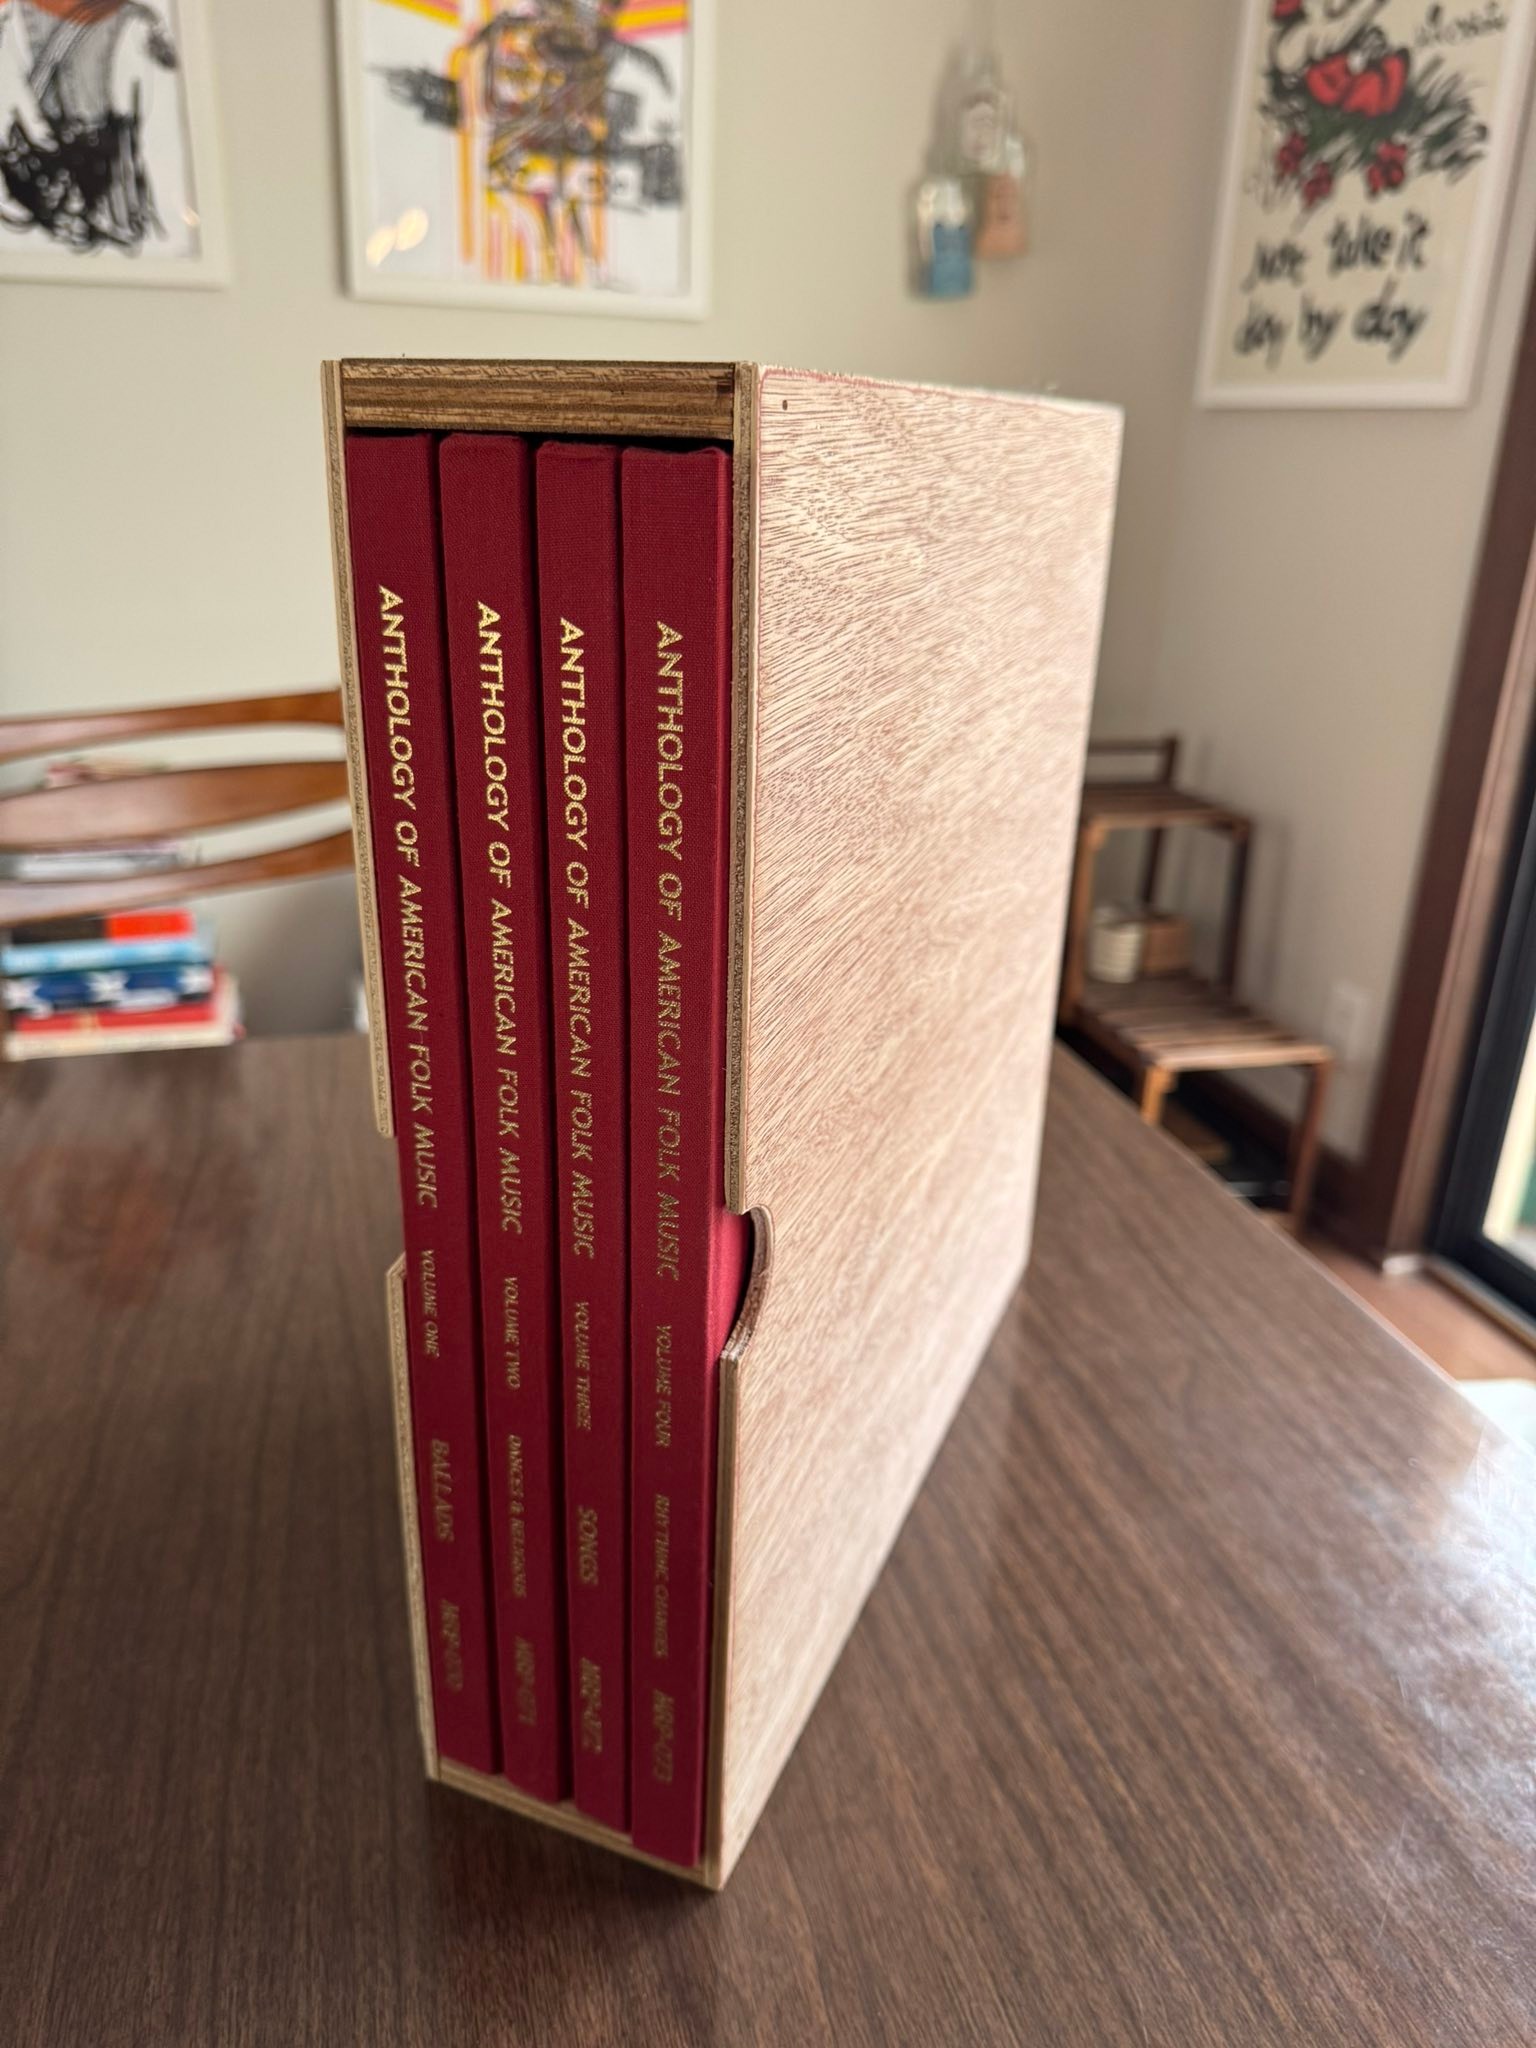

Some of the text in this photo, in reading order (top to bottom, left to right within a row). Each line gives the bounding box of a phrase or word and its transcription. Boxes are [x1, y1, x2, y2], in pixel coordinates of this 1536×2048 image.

[1298, 293, 1344, 363] by
[1353, 277, 1429, 364] day
[379, 584, 416, 811] ANTHOLOGY
[477, 600, 510, 831] ANTHOLOGY
[559, 617, 588, 850] ANTHOLOGY
[657, 620, 684, 860] ANTHOLOGY
[395, 821, 420, 867] OF
[488, 841, 512, 888] OF
[566, 861, 590, 909] OF
[658, 872, 683, 921] OF
[398, 874, 429, 1032] AMERICAN
[491, 898, 517, 1056] AMERICAN
[567, 917, 591, 1078] AMERICAN
[657, 930, 682, 1095] AMERICAN
[409, 1043, 433, 1115] FOLK
[497, 1067, 520, 1139] FOLK
[570, 1089, 593, 1162] FOLK
[657, 1107, 681, 1182] FOLK
[414, 1122, 437, 1209] MUSIC
[499, 1147, 522, 1235] MUSIC
[572, 1170, 595, 1260] MUSIC
[657, 1191, 680, 1281] MUSIC
[421, 1249, 438, 1317] VOLUME
[504, 1276, 520, 1347] VOLUME
[424, 1321, 440, 1358] ONE
[505, 1351, 521, 1391] TWO
[575, 1301, 591, 1371] VOLUME
[656, 1325, 672, 1395] VOLUME
[576, 1375, 592, 1431] THREE
[655, 1400, 672, 1448] FOUR
[431, 1438, 454, 1542] BALLADS
[508, 1434, 525, 1499] DANCES
[510, 1502, 525, 1515] &
[578, 1504, 598, 1585] SONGS
[655, 1494, 670, 1581] RHYTHMIC
[510, 1517, 527, 1598] RELIGIOUS
[655, 1584, 669, 1658] CHANGES
